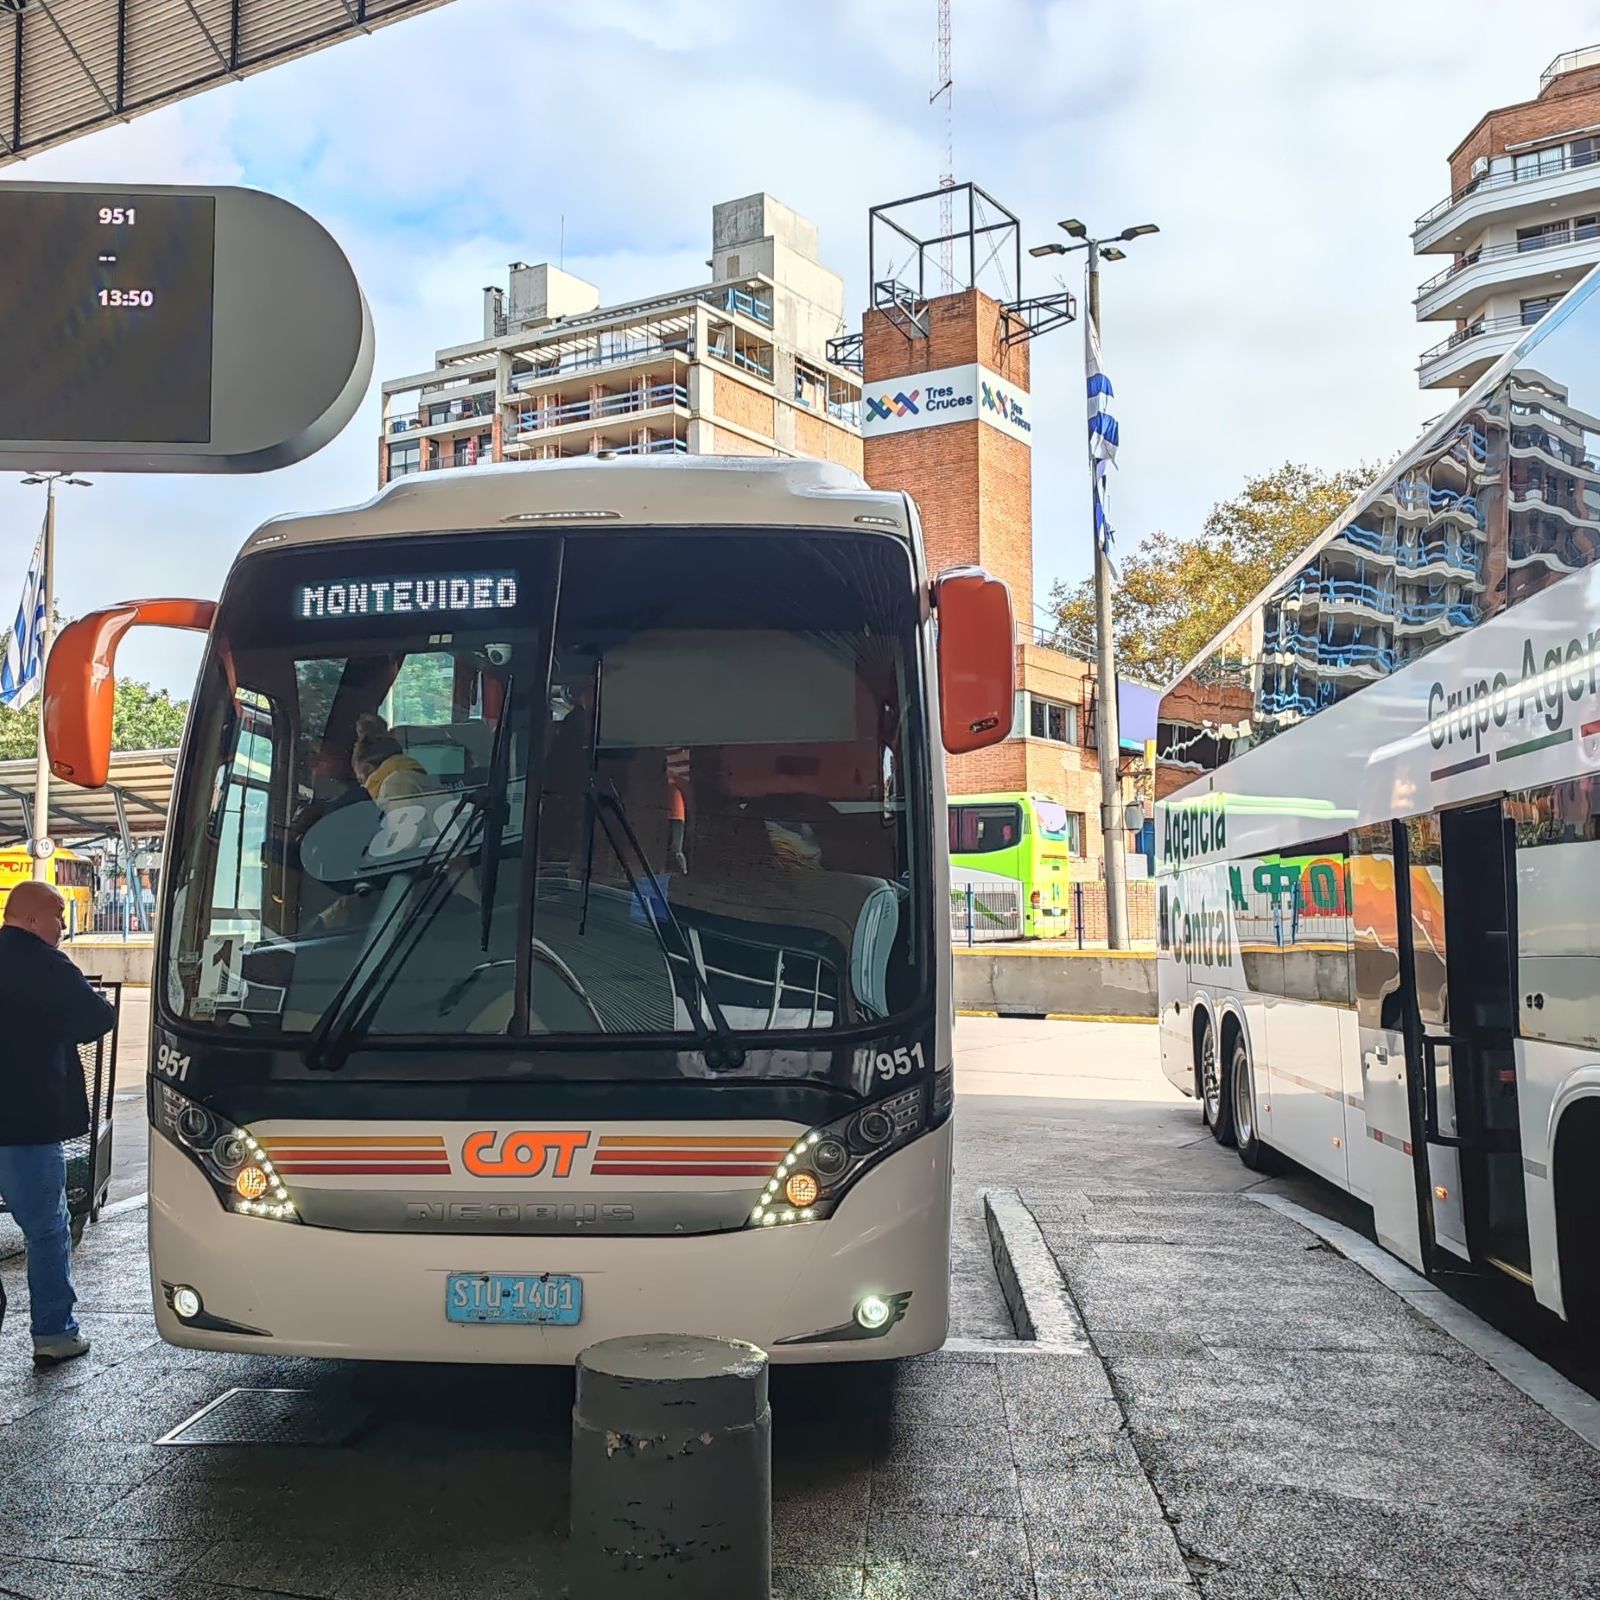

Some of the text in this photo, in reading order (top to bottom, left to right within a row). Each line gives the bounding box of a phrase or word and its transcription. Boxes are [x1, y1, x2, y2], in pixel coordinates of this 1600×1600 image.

[98, 208, 136, 226] 951
[98, 289, 154, 307] 13:50
[925, 386, 954, 400] Tres
[925, 394, 974, 411] Cruces
[302, 577, 517, 617] MONTEVIDEO
[1427, 671, 1508, 754] Grupo
[1163, 776, 1226, 881] Agencia
[10, 861, 33, 873] CIT
[1171, 889, 1232, 968] Central
[156, 1044, 191, 1081] 951
[875, 1042, 926, 1081] 951
[461, 1130, 592, 1178] COT
[406, 1202, 635, 1223] NEOBUS
[512, 1280, 574, 1310] 1401
